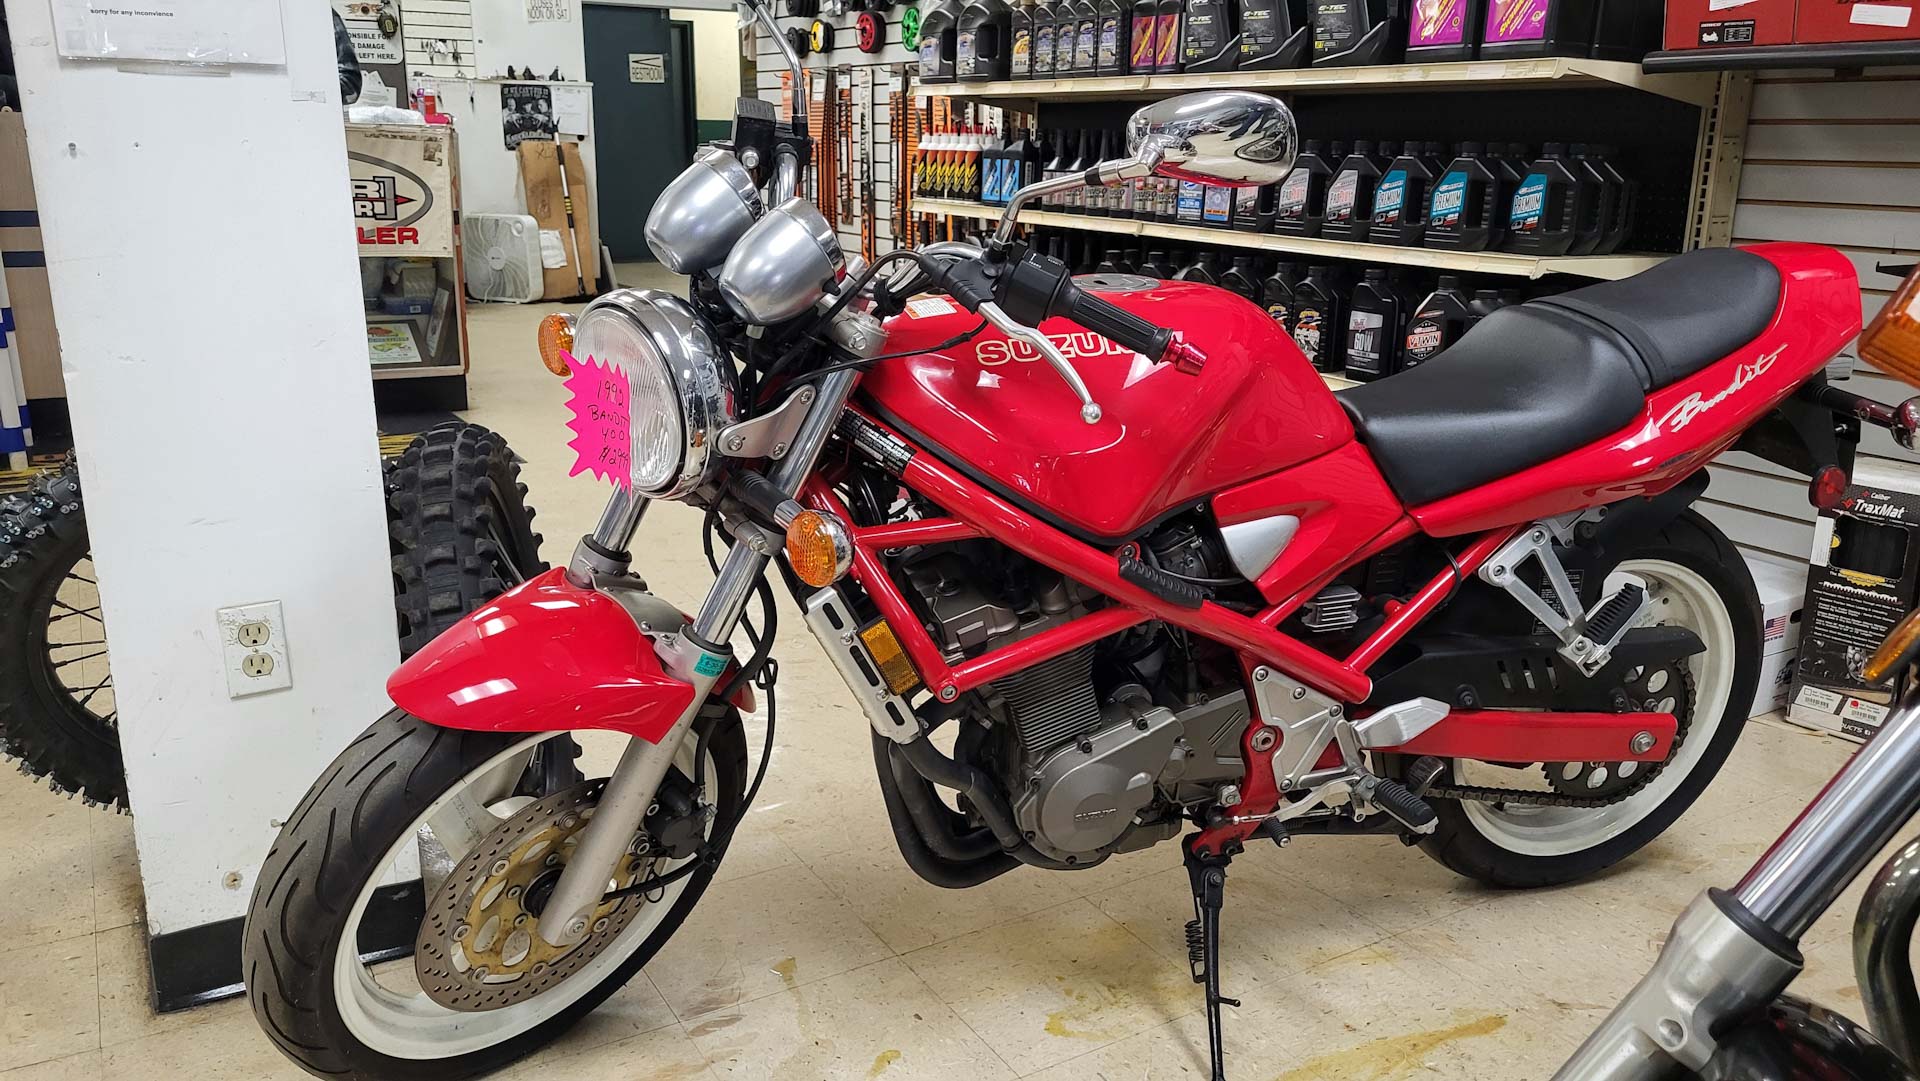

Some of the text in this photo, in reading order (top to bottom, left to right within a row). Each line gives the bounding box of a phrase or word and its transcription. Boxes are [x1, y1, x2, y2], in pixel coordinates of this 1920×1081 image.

[90, 8, 108, 16] sorry
[347, 32, 376, 40] ONSIBLE
[631, 66, 663, 81] RESTROOM
[1375, 187, 1403, 209] PREMIUM
[1433, 189, 1463, 213] PREMIUM
[1512, 192, 1543, 215] PREMIUM
[357, 226, 419, 245] LER
[975, 332, 1136, 366] SUZUK
[597, 380, 624, 408] 1992
[1655, 343, 1788, 433] Bandit
[587, 405, 630, 426] BANDIT
[601, 428, 625, 442] 400
[1870, 492, 1892, 501] Caliber
[1853, 498, 1906, 519] TraxMat
